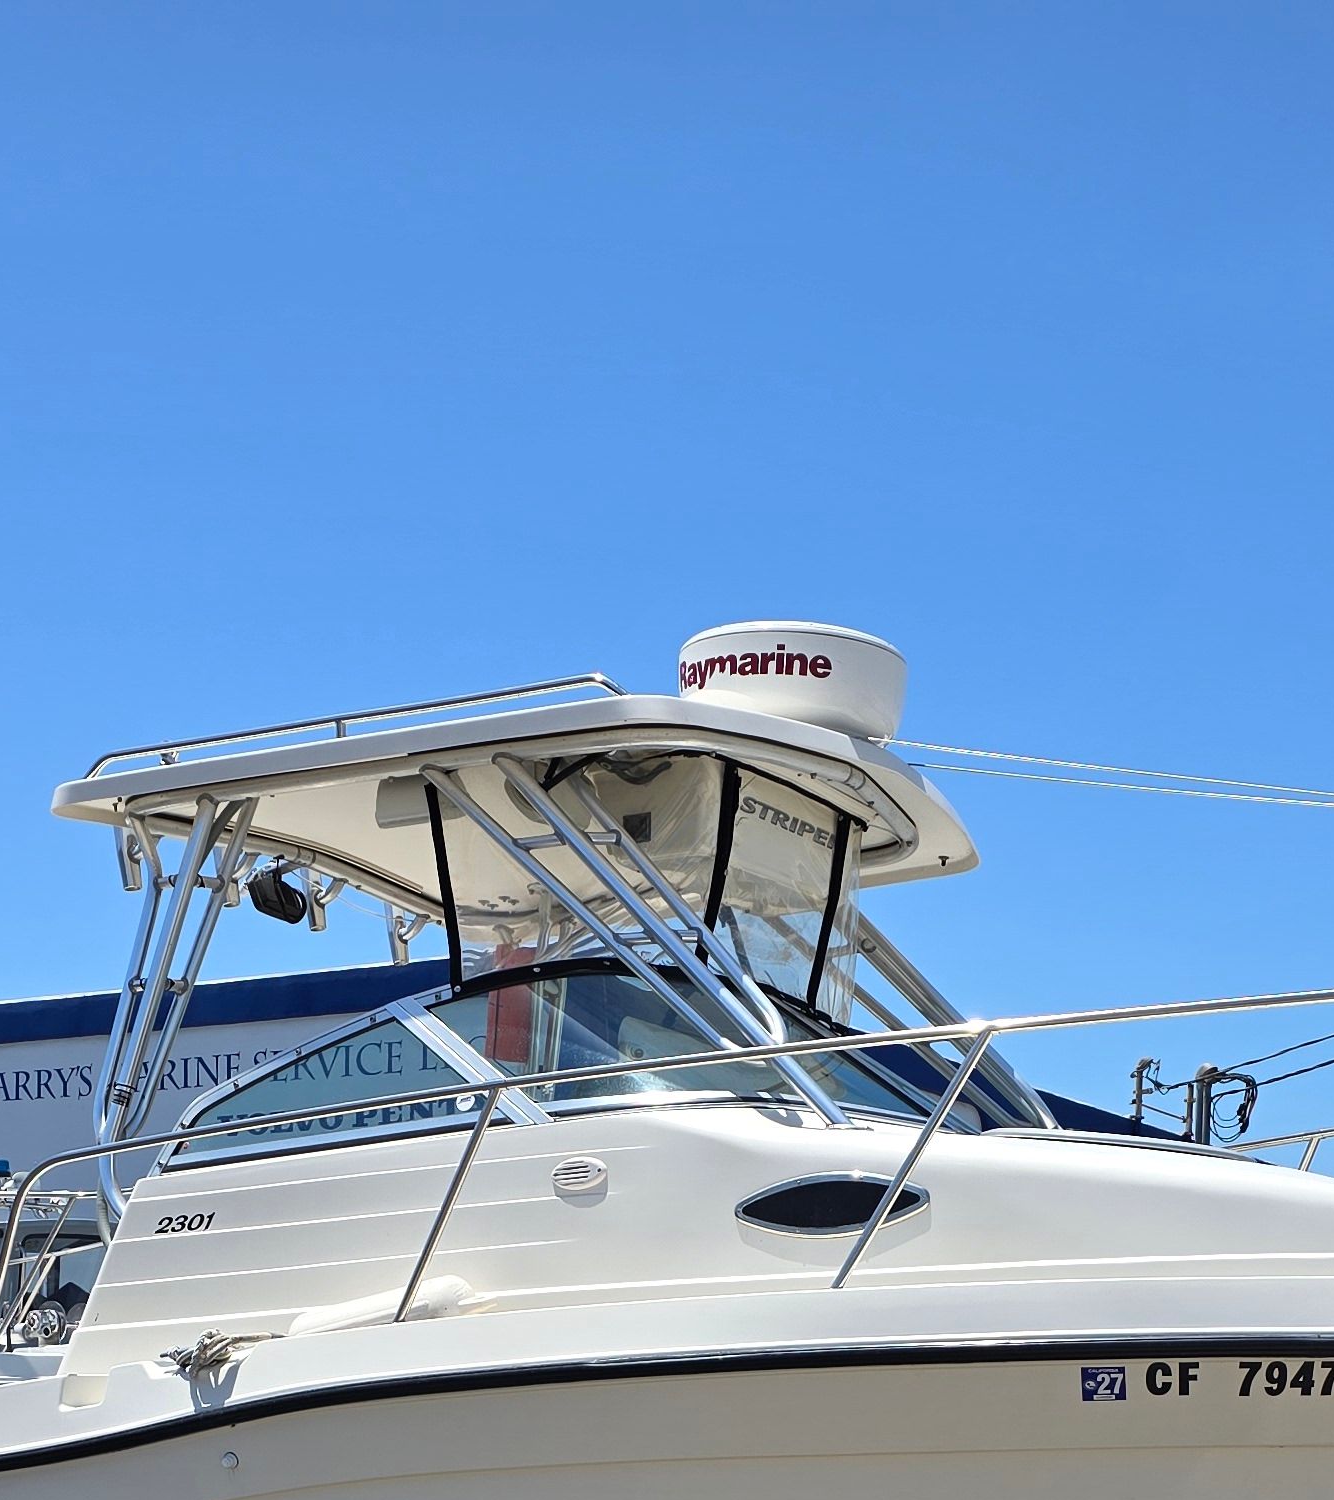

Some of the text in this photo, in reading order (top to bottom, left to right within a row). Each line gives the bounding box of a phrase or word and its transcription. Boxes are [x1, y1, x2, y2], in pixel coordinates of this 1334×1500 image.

[679, 643, 833, 693] Raymarine
[117, 1051, 241, 1092] ARINE
[154, 1211, 216, 1235] 2301
[1096, 1373, 1124, 1395] 27
[1145, 1361, 1200, 1396] CF
